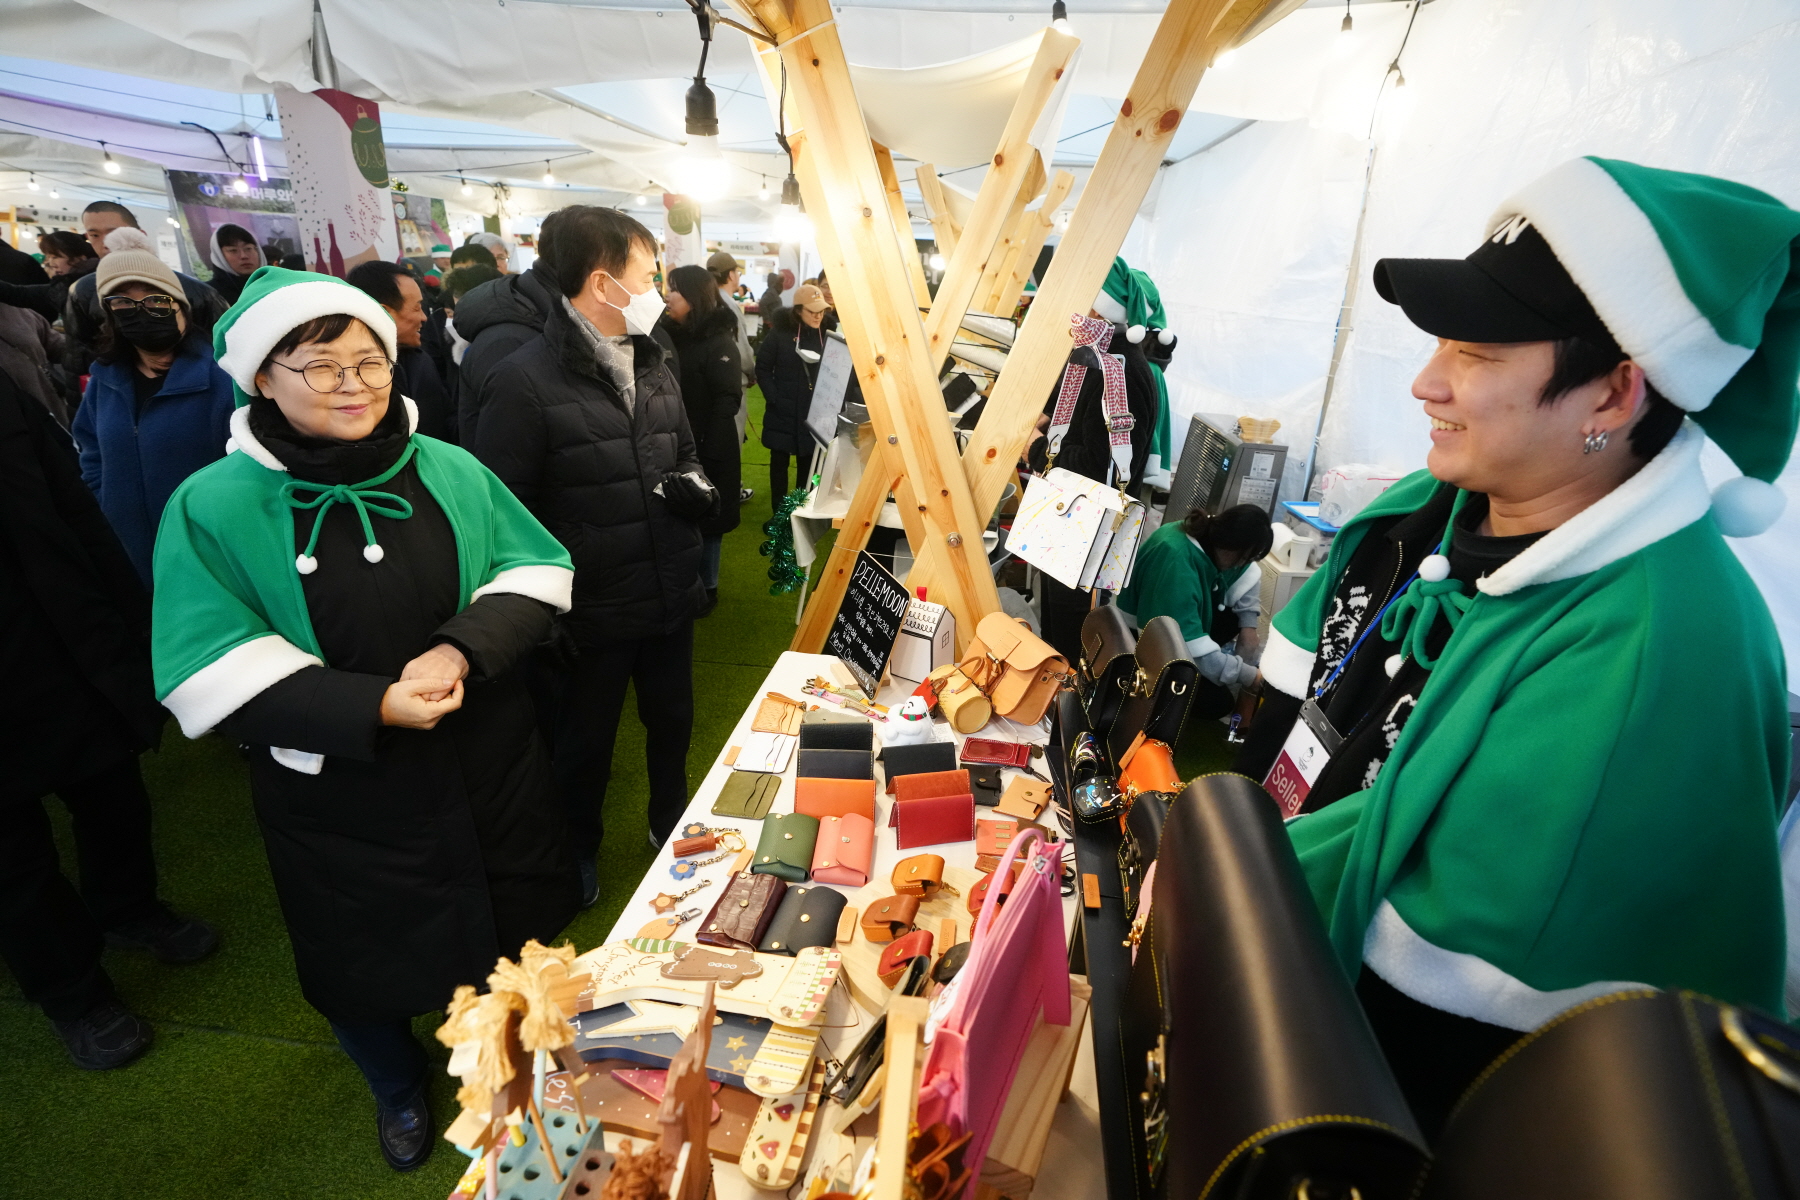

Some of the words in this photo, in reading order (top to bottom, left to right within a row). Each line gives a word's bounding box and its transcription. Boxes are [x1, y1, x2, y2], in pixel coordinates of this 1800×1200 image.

[853, 560, 910, 618] PELLEMOON
[593, 946, 632, 985] Christmas
[607, 955, 665, 985] Sweet
